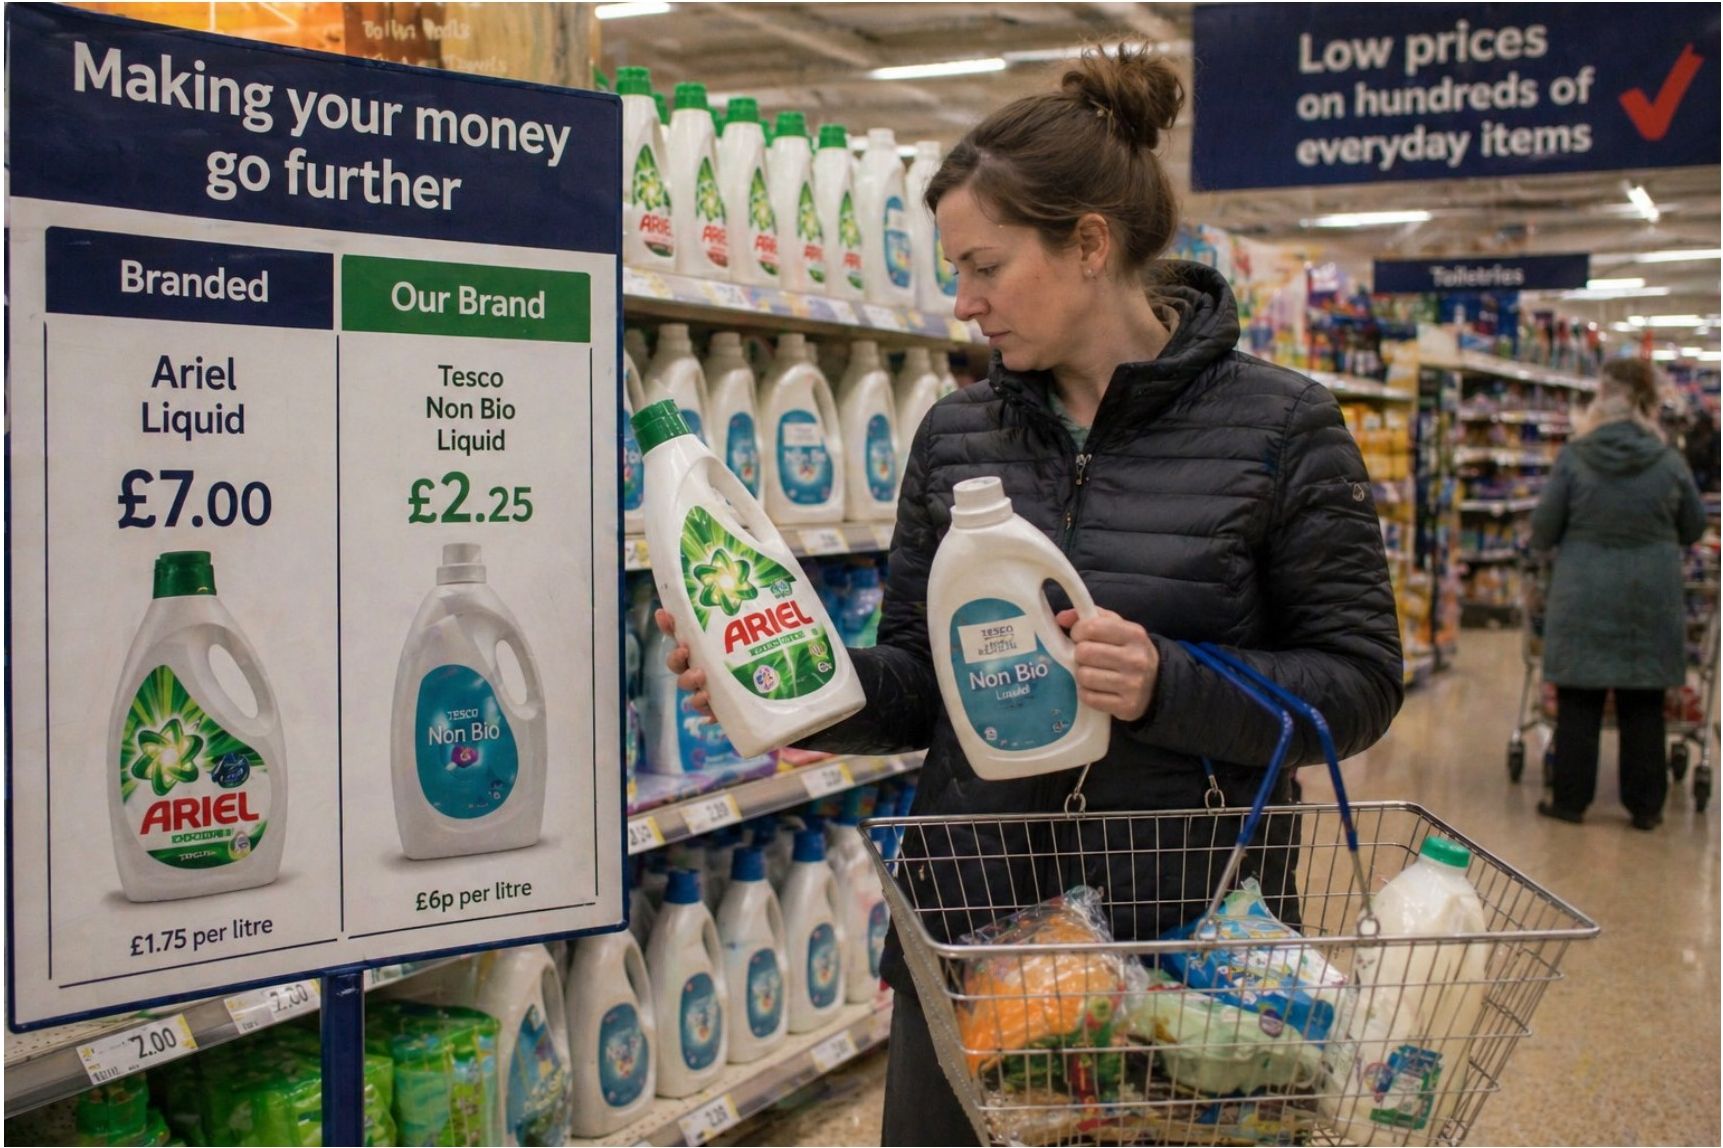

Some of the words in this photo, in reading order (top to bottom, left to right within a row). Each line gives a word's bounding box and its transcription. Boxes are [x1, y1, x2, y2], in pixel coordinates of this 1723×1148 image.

[1300, 33, 1392, 73] Low
[1405, 20, 1547, 74] prices
[73, 41, 274, 133] Making
[286, 88, 403, 137] your
[416, 108, 571, 167] money
[1298, 90, 1345, 120] on
[1355, 74, 1538, 117] hundreds
[1550, 67, 1595, 105] of
[1297, 123, 1469, 169] everyday
[1481, 122, 1592, 157] items
[206, 151, 271, 200] go
[285, 148, 462, 210] further
[121, 259, 269, 302] Branded
[391, 281, 451, 315] Our
[458, 285, 545, 319] Brand
[151, 355, 237, 390] Ariel
[438, 365, 503, 388] Tesco
[142, 402, 245, 441] Liquid
[426, 397, 473, 419] Non
[481, 398, 516, 420] Bio
[437, 429, 505, 456] Liquid
[117, 469, 272, 529] £7.00
[408, 471, 533, 524] £2.25
[724, 600, 814, 654] ARIEL
[969, 671, 1010, 690] Non
[1015, 662, 1048, 682] Bio
[429, 725, 466, 746] Non
[471, 722, 500, 741] Bio
[448, 709, 478, 720] TESCO
[140, 792, 259, 835] ARIEL
[416, 890, 454, 914] £6p
[460, 886, 490, 909] per
[496, 880, 532, 900] litre
[130, 929, 186, 956] £1.75
[193, 925, 227, 953] per
[233, 917, 273, 939] litre
[130, 1027, 177, 1059] 2.00
